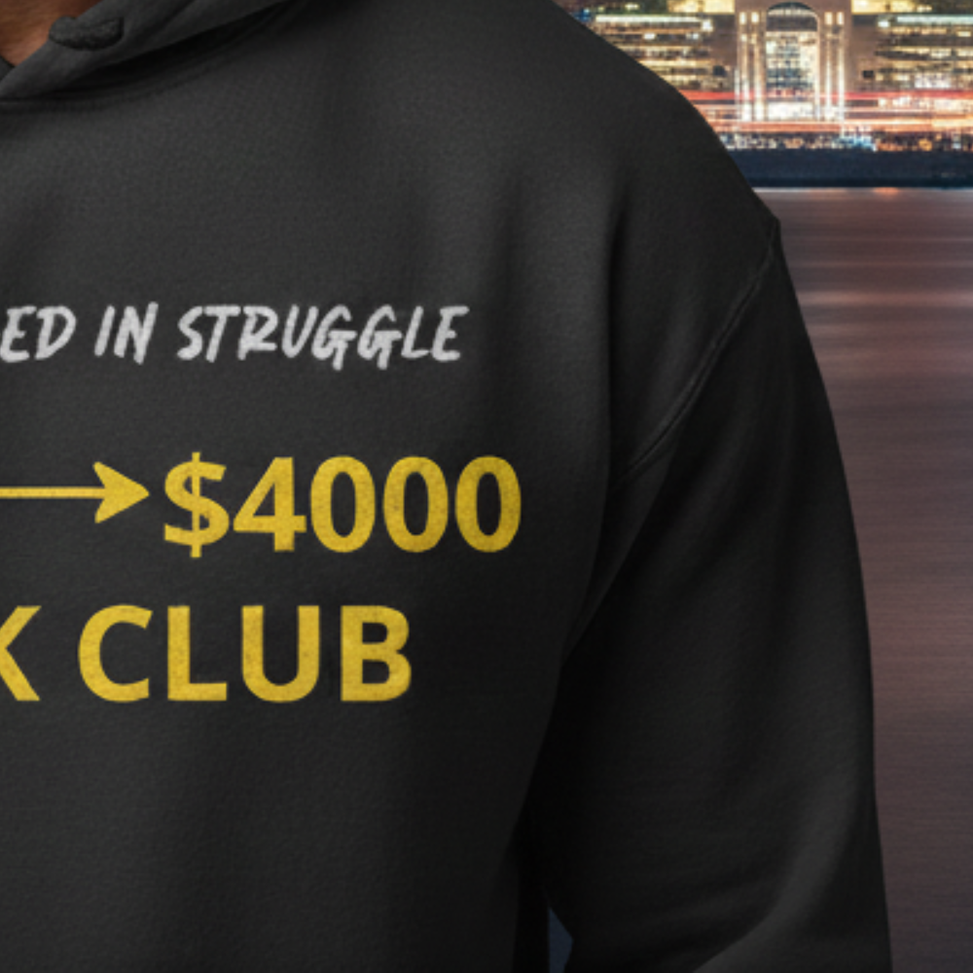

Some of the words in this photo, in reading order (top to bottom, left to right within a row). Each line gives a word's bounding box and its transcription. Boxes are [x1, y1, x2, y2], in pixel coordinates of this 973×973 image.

[93, 301, 159, 365] IN
[176, 304, 470, 372] STRUGGLE
[163, 450, 521, 559] $4000
[77, 604, 412, 704] CLUB
